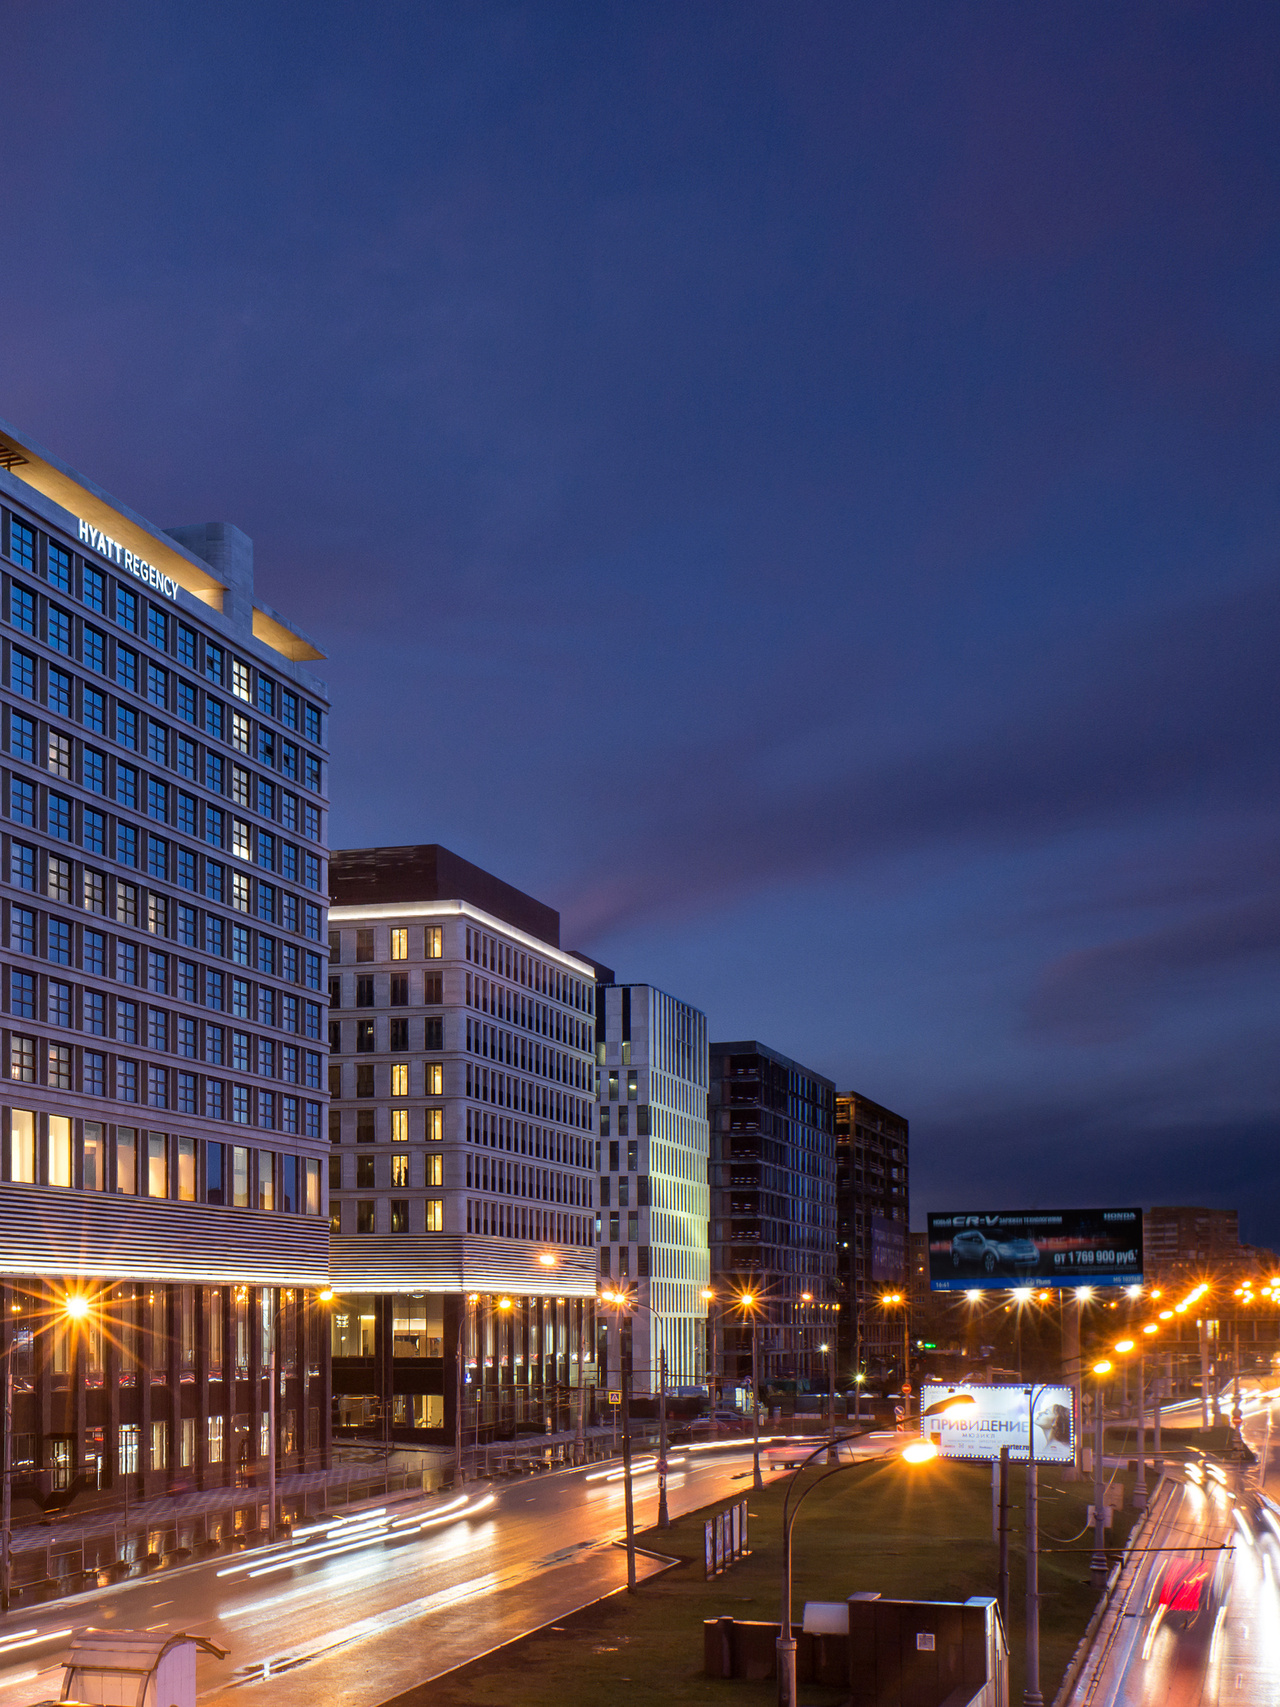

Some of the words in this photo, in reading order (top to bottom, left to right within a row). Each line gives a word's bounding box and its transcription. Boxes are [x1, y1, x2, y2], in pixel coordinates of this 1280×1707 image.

[78, 518, 122, 564] HYATT
[124, 548, 179, 601] REGENCY
[952, 1215, 999, 1227] CR-V
[1103, 1212, 1136, 1221] HONDA
[1068, 1251, 1074, 1265] 1
[1075, 1250, 1094, 1265] 769
[1096, 1250, 1115, 1265] 900
[930, 1418, 1029, 1432] ПРИВИДЕНИЕ
